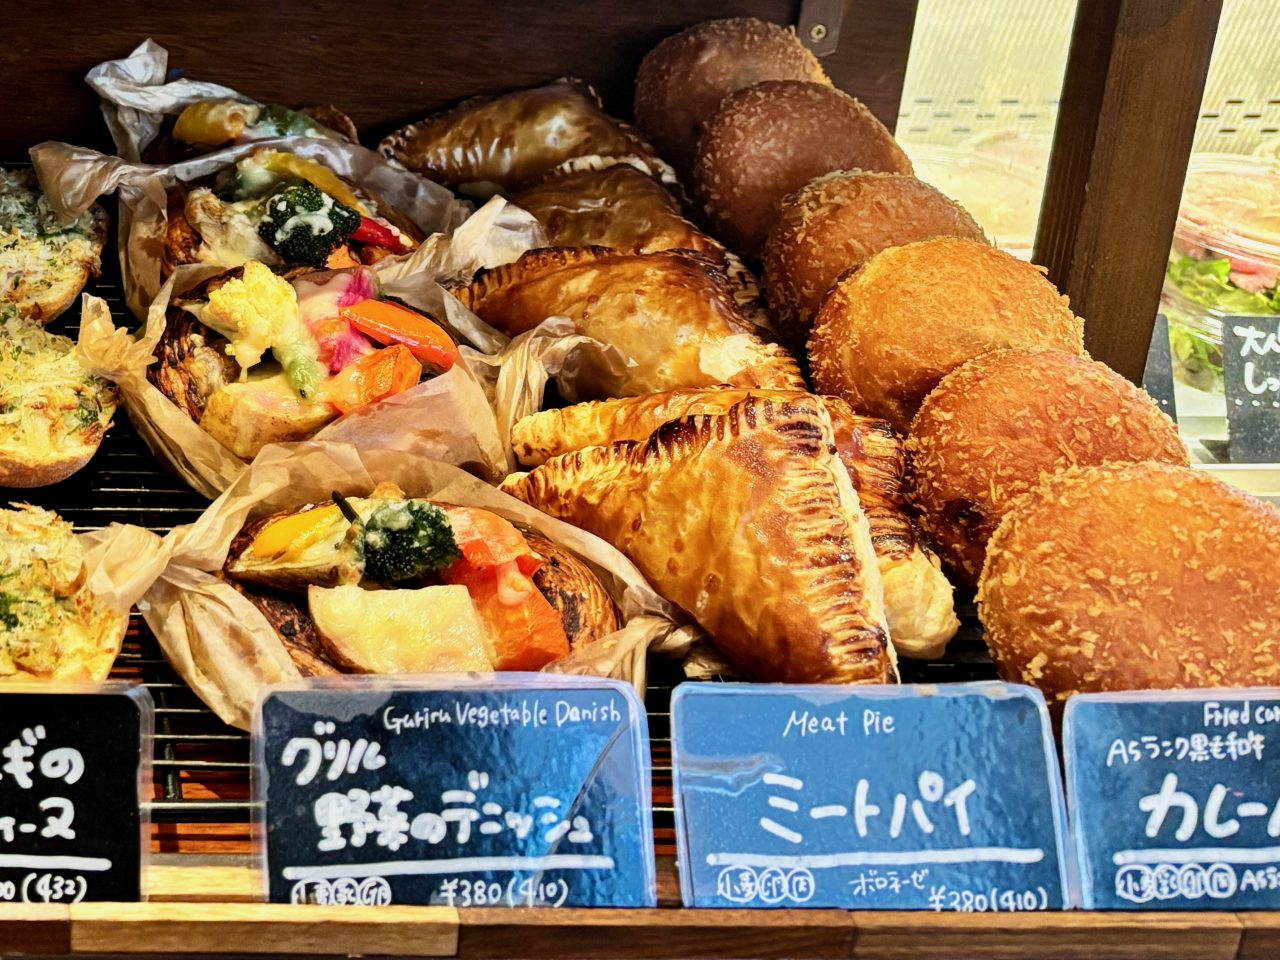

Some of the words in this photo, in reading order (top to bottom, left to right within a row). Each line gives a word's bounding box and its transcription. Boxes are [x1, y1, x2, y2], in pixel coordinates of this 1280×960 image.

[455, 700, 548, 728] Vegetable
[555, 699, 620, 727] Danish
[783, 710, 848, 736] Meat
[863, 709, 895, 734] Pie
[1204, 701, 1250, 727] Fried
[281, 721, 386, 785] グリル
[315, 769, 593, 851] 野菜のデニッシュ
[760, 770, 976, 843] ミートパイ
[440, 879, 568, 906] ¥380(410)
[849, 869, 929, 896] ボロネーゼ
